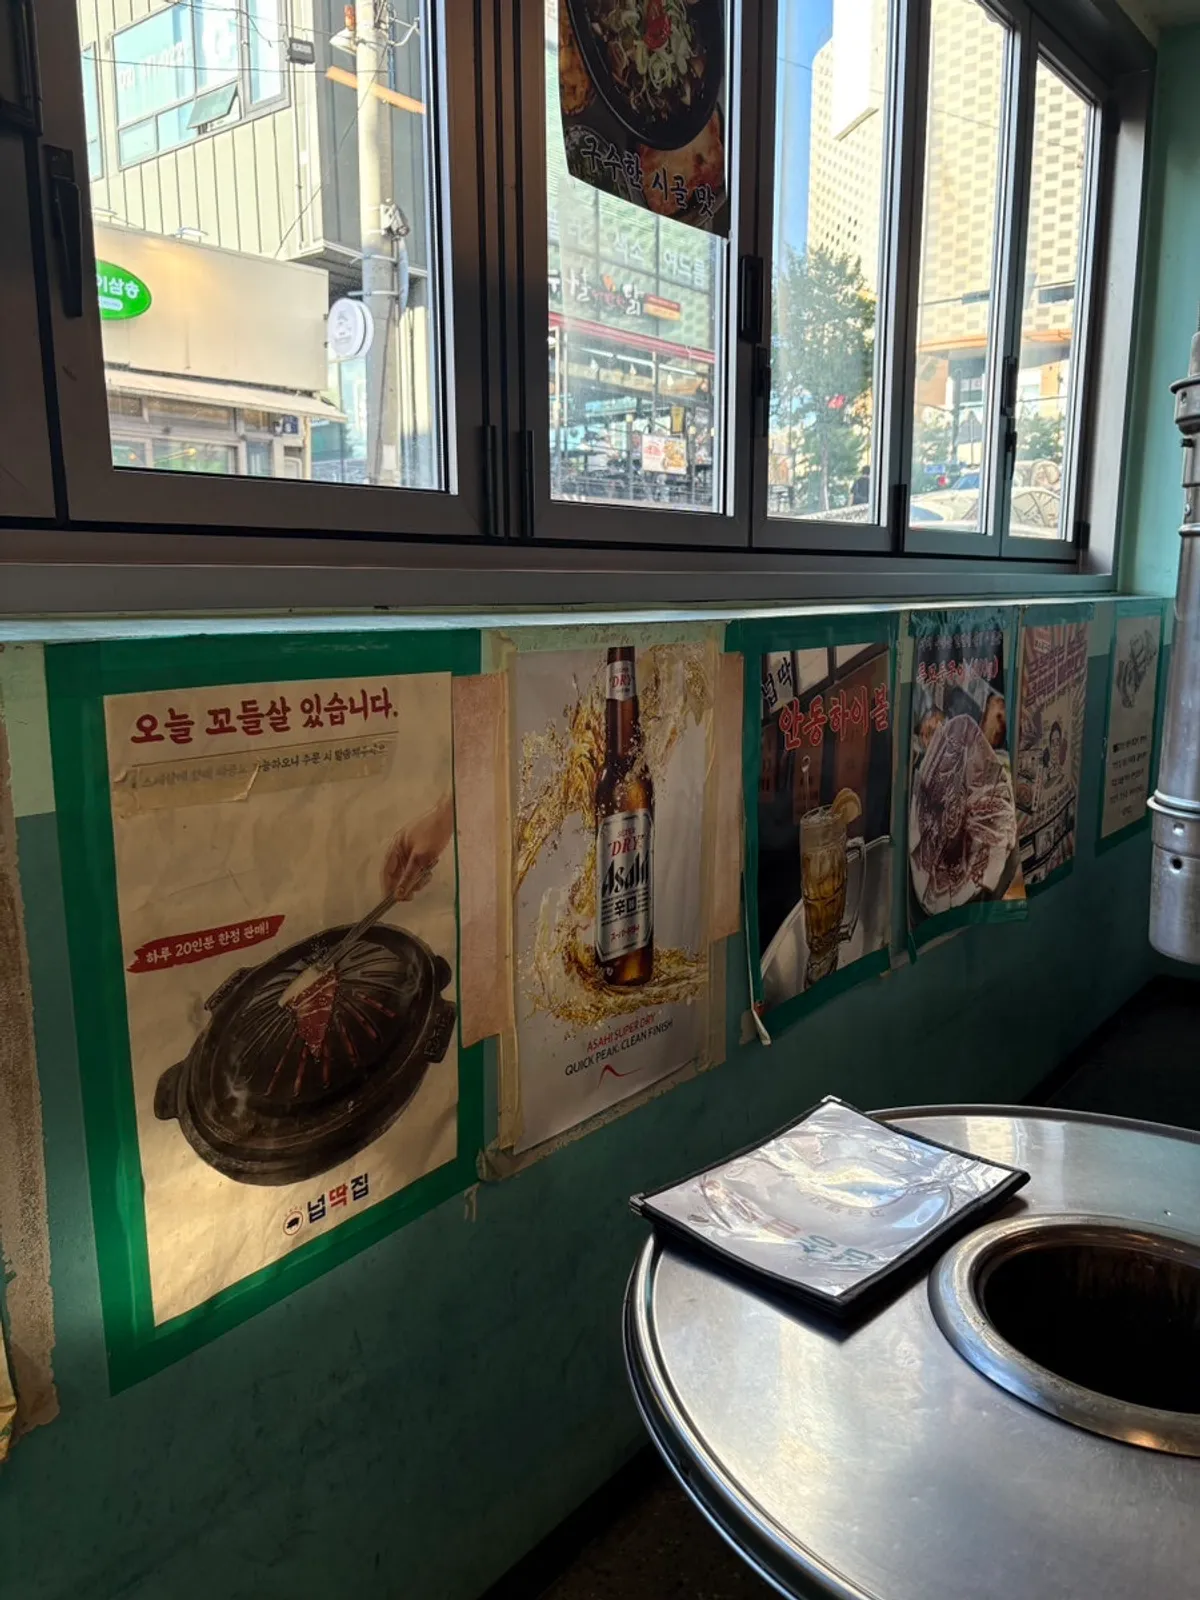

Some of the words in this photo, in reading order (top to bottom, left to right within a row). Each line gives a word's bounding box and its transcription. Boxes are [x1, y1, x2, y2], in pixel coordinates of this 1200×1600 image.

[581, 134, 643, 190] 구수한
[652, 167, 688, 211] 시골
[693, 184, 716, 219] 맛
[664, 249, 706, 286] 여드름
[130, 708, 195, 745] 오늘
[205, 696, 291, 736] 꼬들살
[299, 686, 399, 729] 있습니다.
[778, 682, 890, 751] 안동하이볼
[145, 946, 172, 964] 하루
[174, 935, 216, 958] 20인분
[218, 928, 241, 946] 한정
[243, 919, 271, 940] 판매!
[564, 1055, 595, 1077] QUICK
[620, 1028, 647, 1052] CLEAN
[647, 1016, 674, 1038] FINISH
[586, 1033, 614, 1054] ASAHI
[614, 1020, 640, 1041] SUPER
[640, 1012, 656, 1029] DRY
[307, 1173, 369, 1224] 넙딱집
